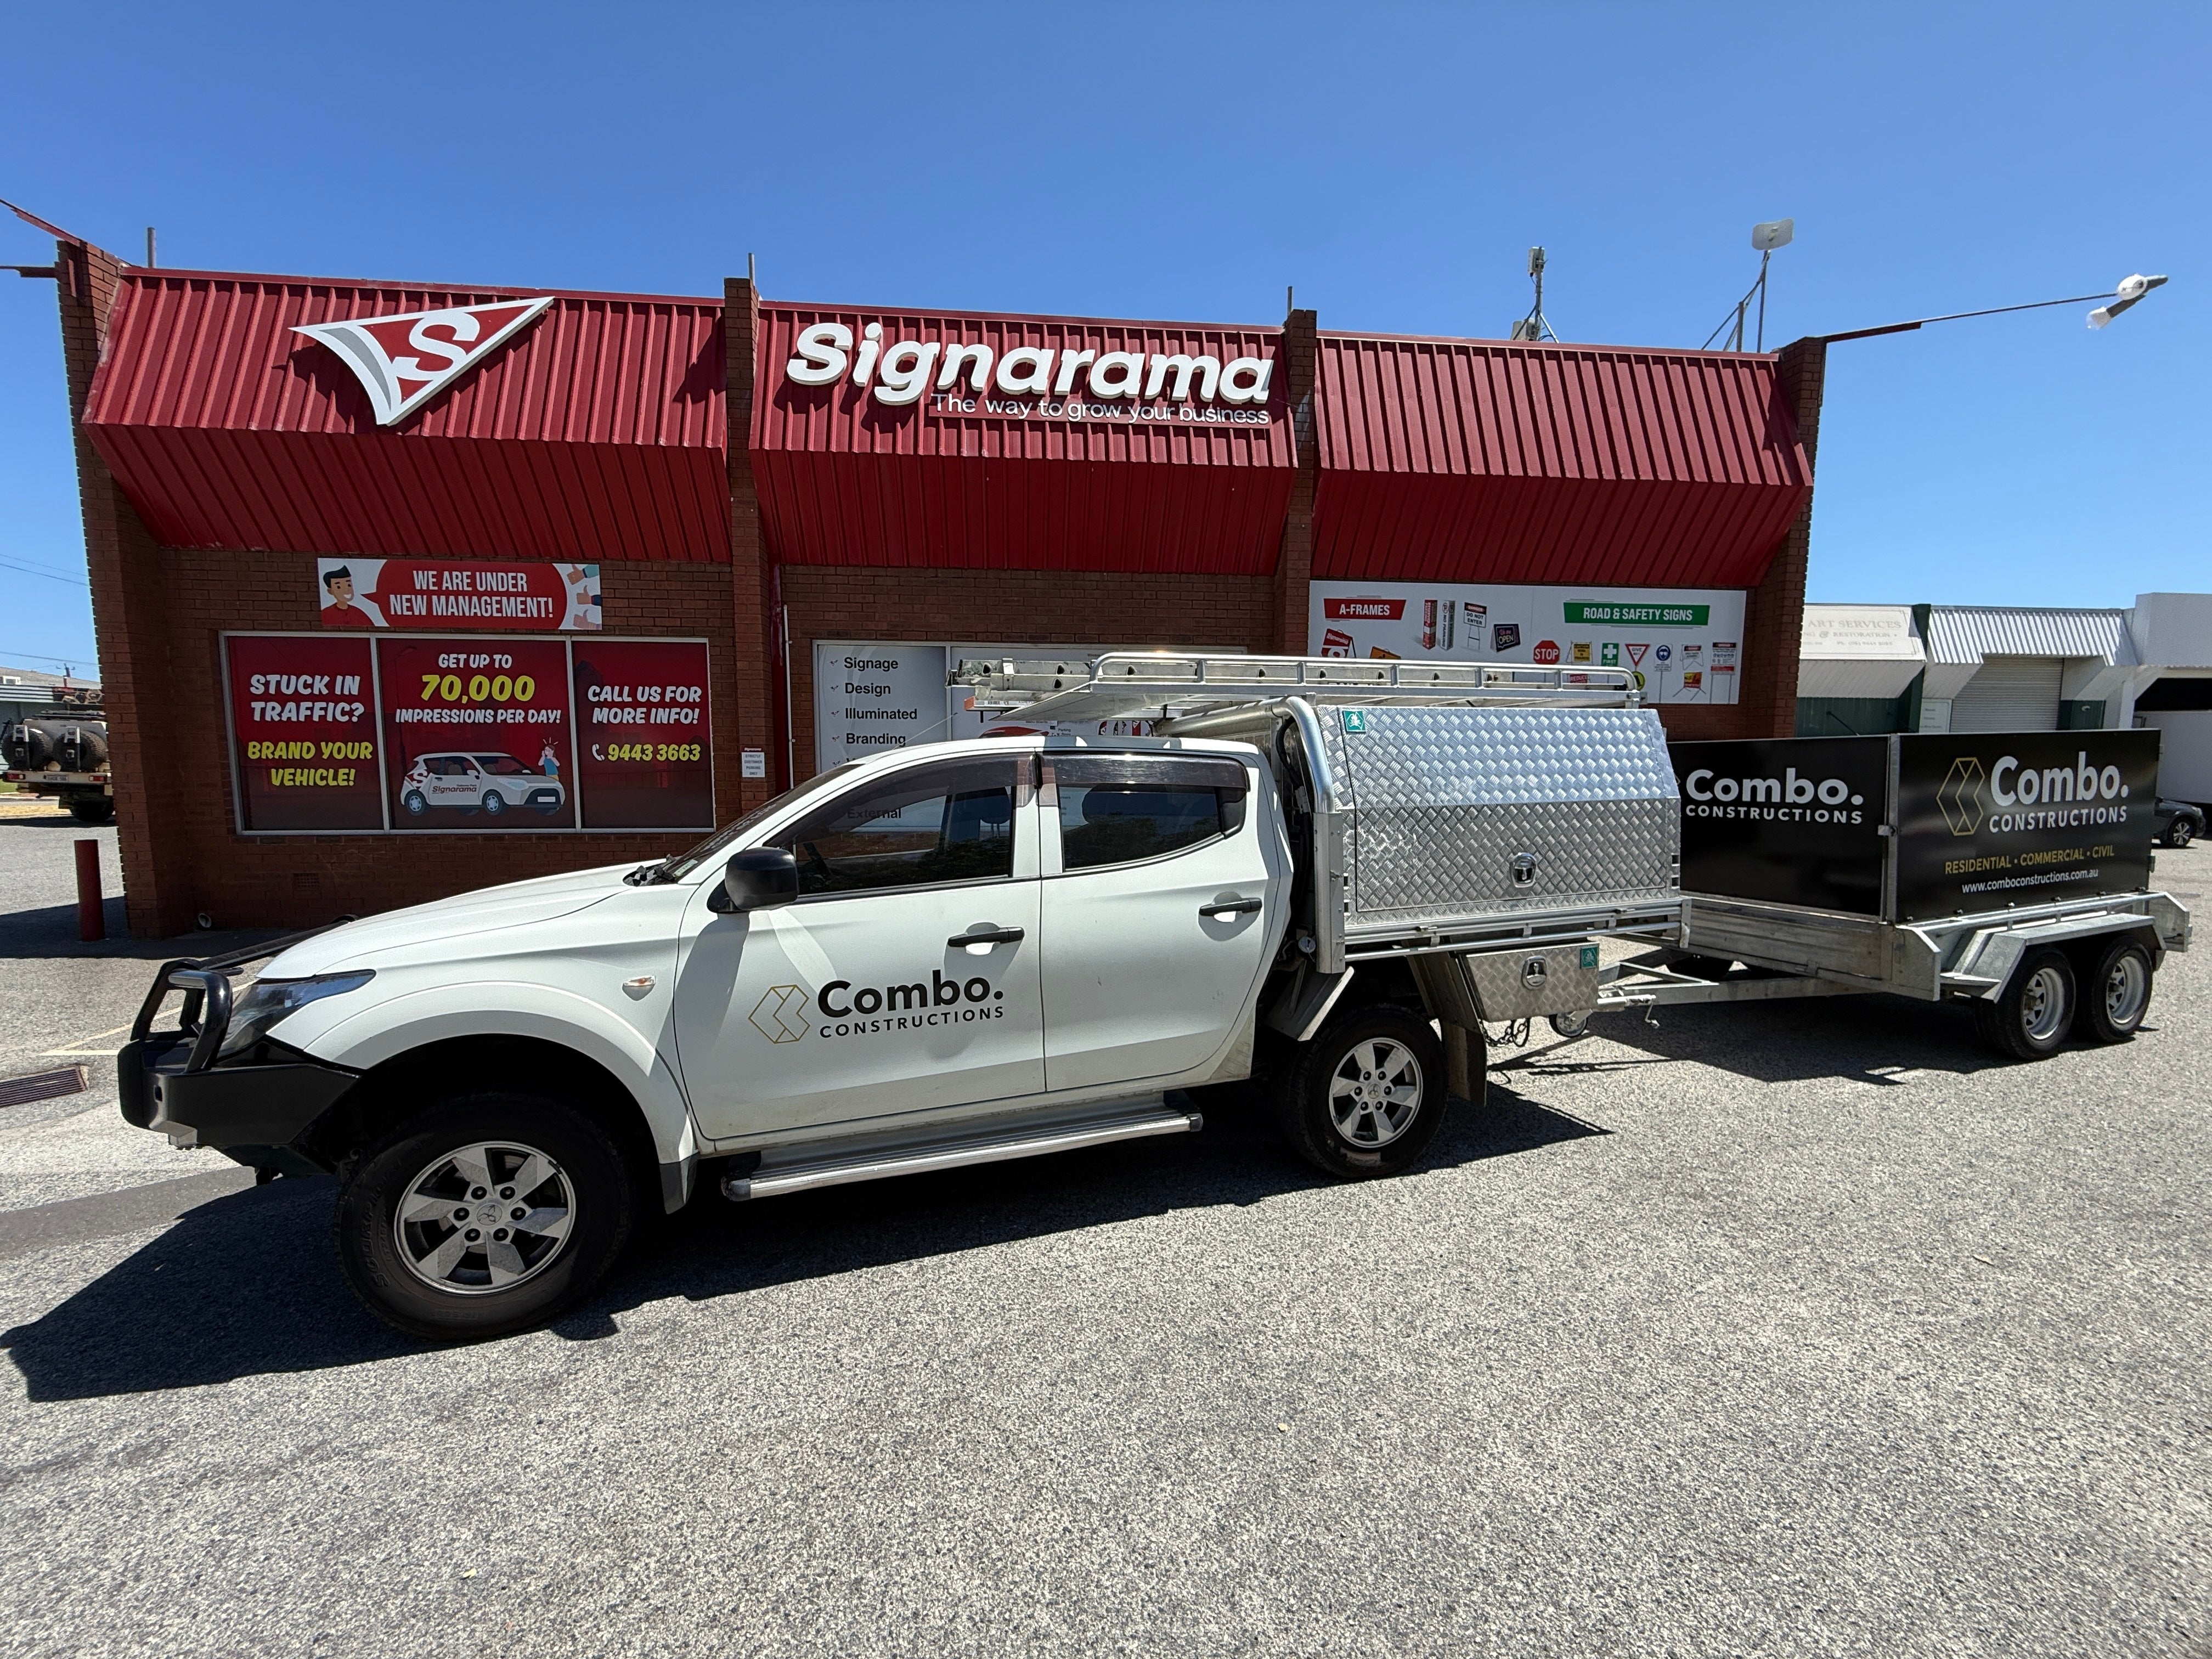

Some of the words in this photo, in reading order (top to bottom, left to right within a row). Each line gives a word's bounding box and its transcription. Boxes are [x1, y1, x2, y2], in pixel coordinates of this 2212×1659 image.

[787, 322, 1274, 405] Signarama
[932, 393, 975, 413] The
[986, 400, 1033, 419] way
[1039, 398, 1062, 416] to
[1068, 403, 1121, 422] grow
[1128, 405, 1175, 424] your
[1180, 403, 1269, 424] business
[413, 570, 438, 590] WE
[442, 571, 472, 591] ARE
[476, 572, 527, 592] UNDER
[390, 594, 427, 616] NEW
[432, 595, 553, 618] MANAGEMENT!
[1339, 603, 1390, 616] A-FRAMES
[1583, 607, 1611, 619] ROAD
[1612, 608, 1621, 619] &
[1622, 608, 1661, 620] SAFETY
[1663, 609, 1693, 621] SIGNS
[1499, 635, 1514, 644] OPEN
[438, 653, 467, 668] GET
[469, 654, 490, 668] UP
[493, 654, 512, 669] TO
[1534, 648, 1559, 661] STOP
[844, 656, 899, 672] Signage
[250, 674, 329, 695] STUCK
[335, 675, 360, 696] IN
[421, 674, 535, 704] 70,000
[588, 685, 633, 702] CALL
[636, 686, 662, 702] US
[665, 686, 702, 703] FOR
[845, 682, 891, 697] Design
[251, 701, 365, 723] TRAFFIC?
[396, 708, 494, 724] IMPRESSIONS
[496, 709, 525, 724] PER
[527, 709, 561, 724] DAY!
[592, 707, 646, 724] MORE
[650, 707, 700, 724] INFO!
[845, 707, 917, 720] Illuminated
[846, 732, 906, 747] Branding
[247, 741, 315, 759] BRAND
[320, 741, 373, 760] YOUR
[607, 744, 653, 761] 9443
[656, 744, 701, 761] 3663
[271, 768, 356, 786] VEHICLE!
[1989, 751, 2129, 806] Combo.
[432, 786, 477, 794] Signarama
[1686, 768, 1864, 805] Combo.
[848, 808, 901, 819] External
[1686, 805, 1863, 824] CONSTRUCTIONS
[1989, 805, 2128, 833] CONSTRUCTIONS
[1945, 856, 2012, 874] RESIDENTIAL
[2020, 848, 2085, 865] COMMERCIAL
[2092, 845, 2115, 858] CIVIL
[1961, 868, 2099, 894] www.comboconstructions.com.au
[817, 969, 1003, 1018] Combo.
[819, 1006, 1004, 1038] CONSTRUCTIONS
